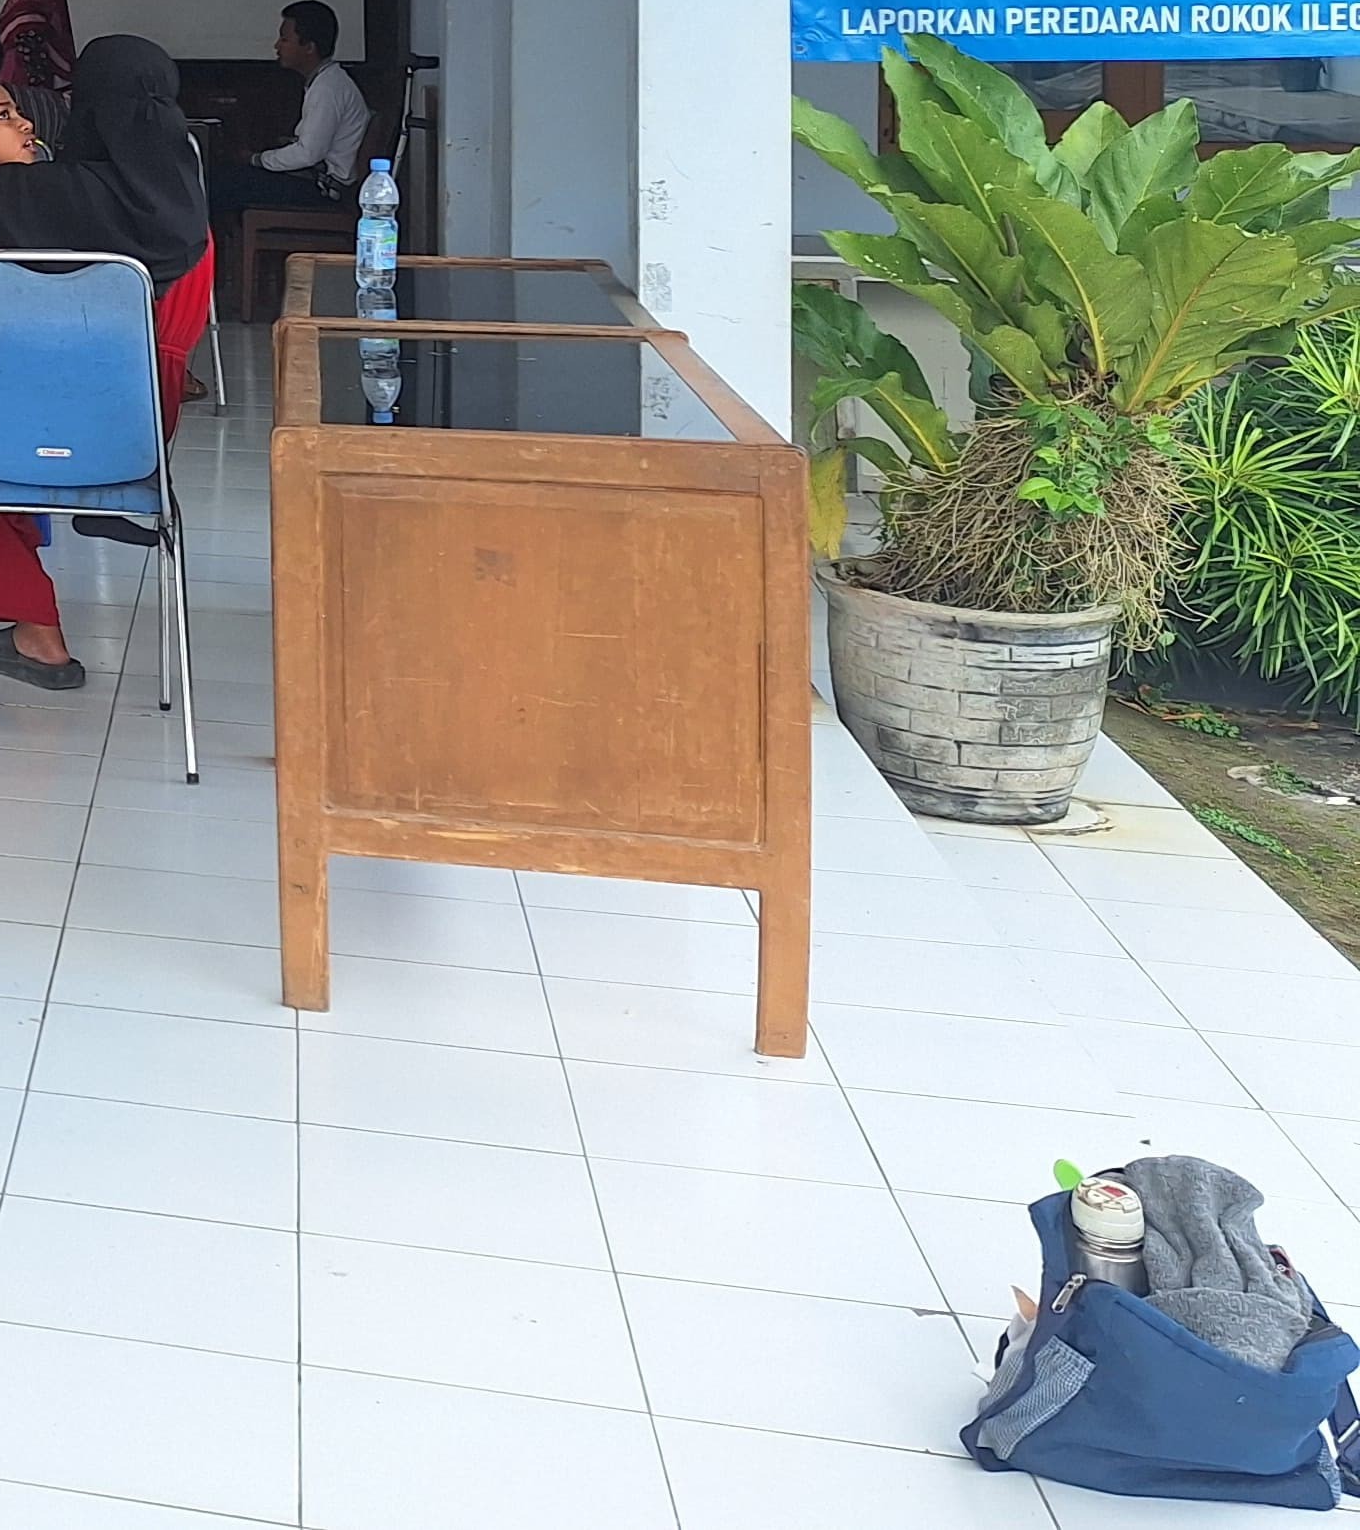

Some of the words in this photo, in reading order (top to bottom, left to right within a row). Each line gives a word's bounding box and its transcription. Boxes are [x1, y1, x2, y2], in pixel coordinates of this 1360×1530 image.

[841, 8, 995, 35] LAPORKAN
[1006, 6, 1180, 35] PEREDARAN
[1191, 3, 1293, 33] ROKOK
